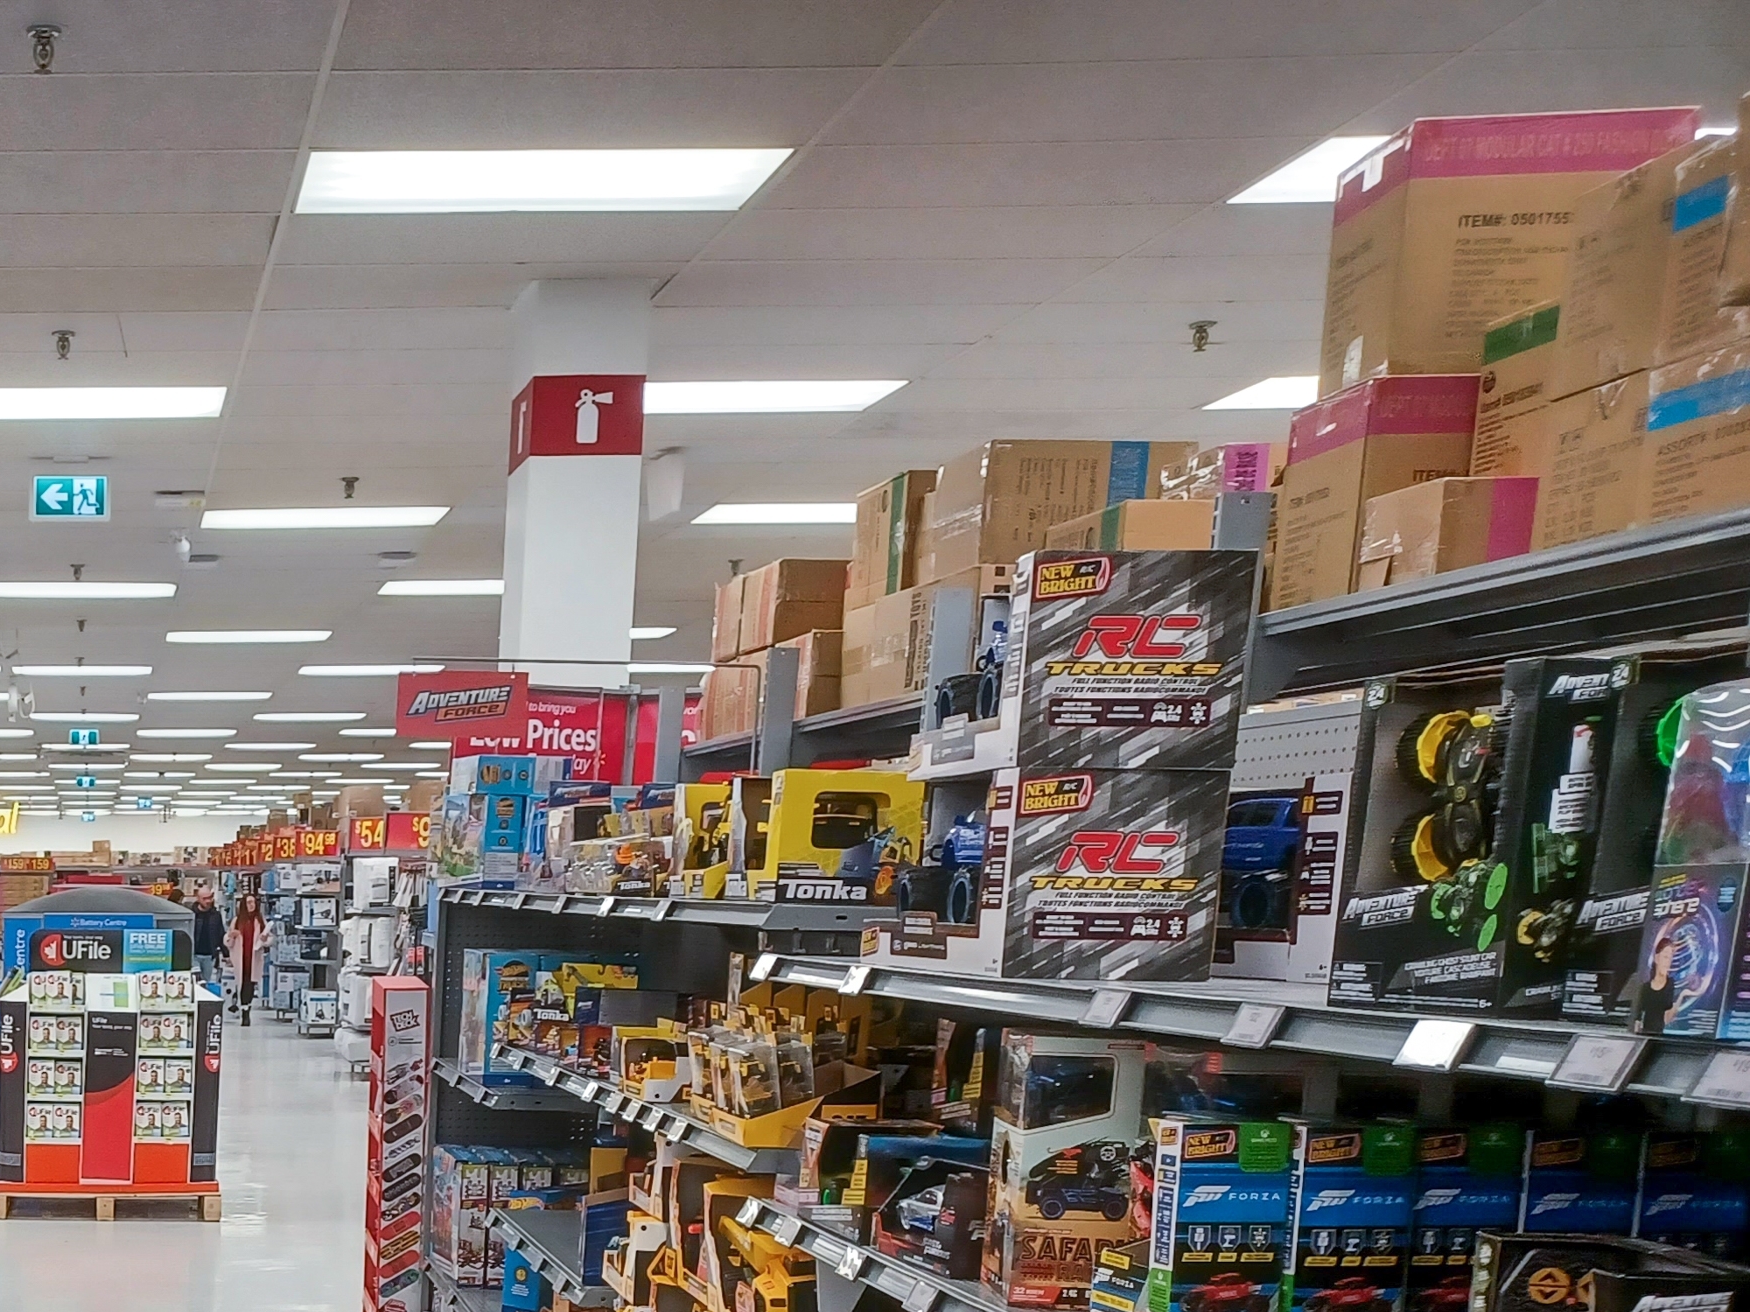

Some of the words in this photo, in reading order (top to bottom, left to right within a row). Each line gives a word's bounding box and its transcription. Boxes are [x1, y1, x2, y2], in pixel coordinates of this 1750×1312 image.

[1040, 564, 1074, 581] NEW
[1040, 576, 1095, 595] BRIGHT
[1073, 613, 1201, 660] RC
[1047, 661, 1221, 677] TRUCKS
[406, 685, 512, 716] ADVENTURE
[442, 702, 500, 719] FORCE
[526, 718, 598, 752] Prices
[1024, 781, 1058, 797] NEW
[1024, 792, 1079, 810] BRIGHT
[1055, 830, 1179, 874] RC
[618, 881, 651, 891] Tonka
[779, 879, 867, 900] Tonka
[1032, 876, 1199, 891] TRUCKS
[104, 918, 127, 927] Centre
[129, 932, 167, 944] FREE
[62, 941, 112, 960] UFile
[534, 1009, 569, 1021] Tonka
[0, 1014, 14, 1055] UFile
[208, 1014, 221, 1055] UFile
[1187, 1134, 1209, 1147] NEW
[1186, 1142, 1228, 1157] BRIGHT
[1228, 1190, 1281, 1202] FORZA
[1352, 1194, 1405, 1206] FORZA
